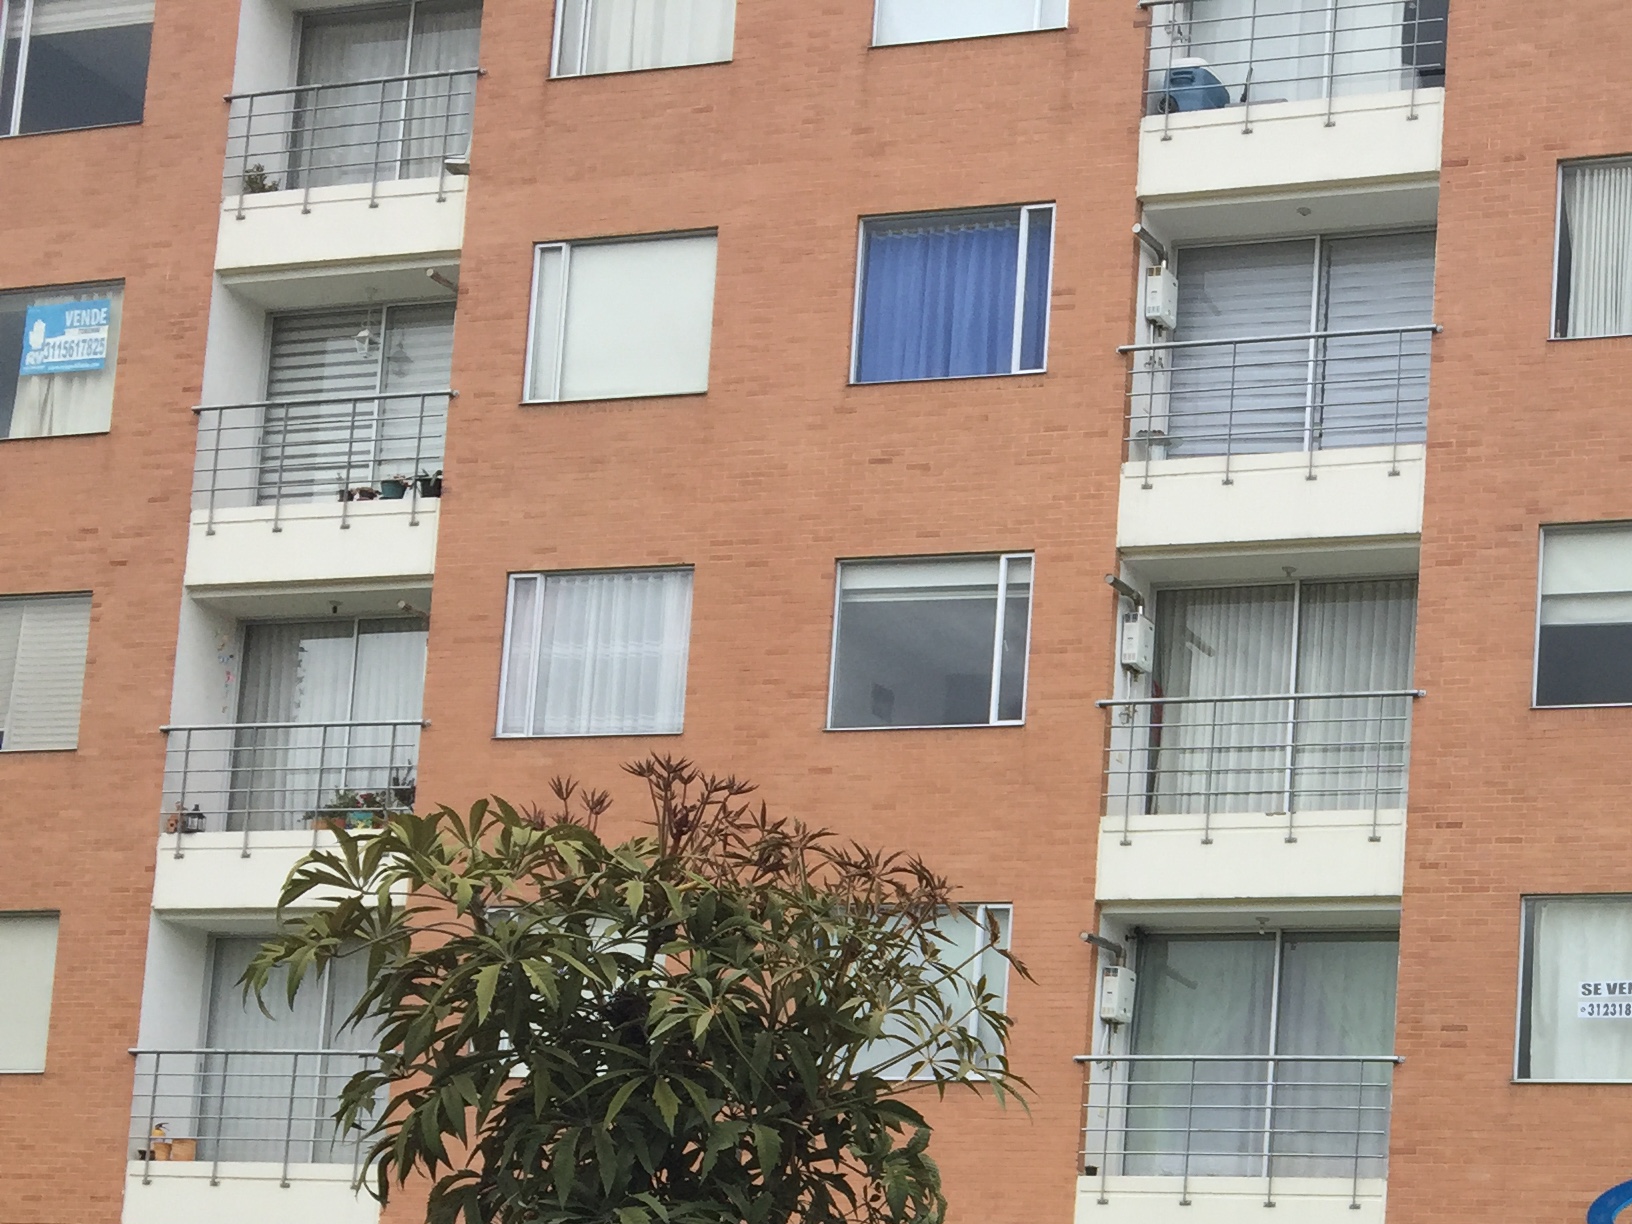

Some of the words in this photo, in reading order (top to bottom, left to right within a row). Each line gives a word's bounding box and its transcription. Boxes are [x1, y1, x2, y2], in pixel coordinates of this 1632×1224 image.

[65, 308, 108, 326] VENDE
[43, 337, 106, 360] 3115617825
[1581, 983, 1602, 996] SE
